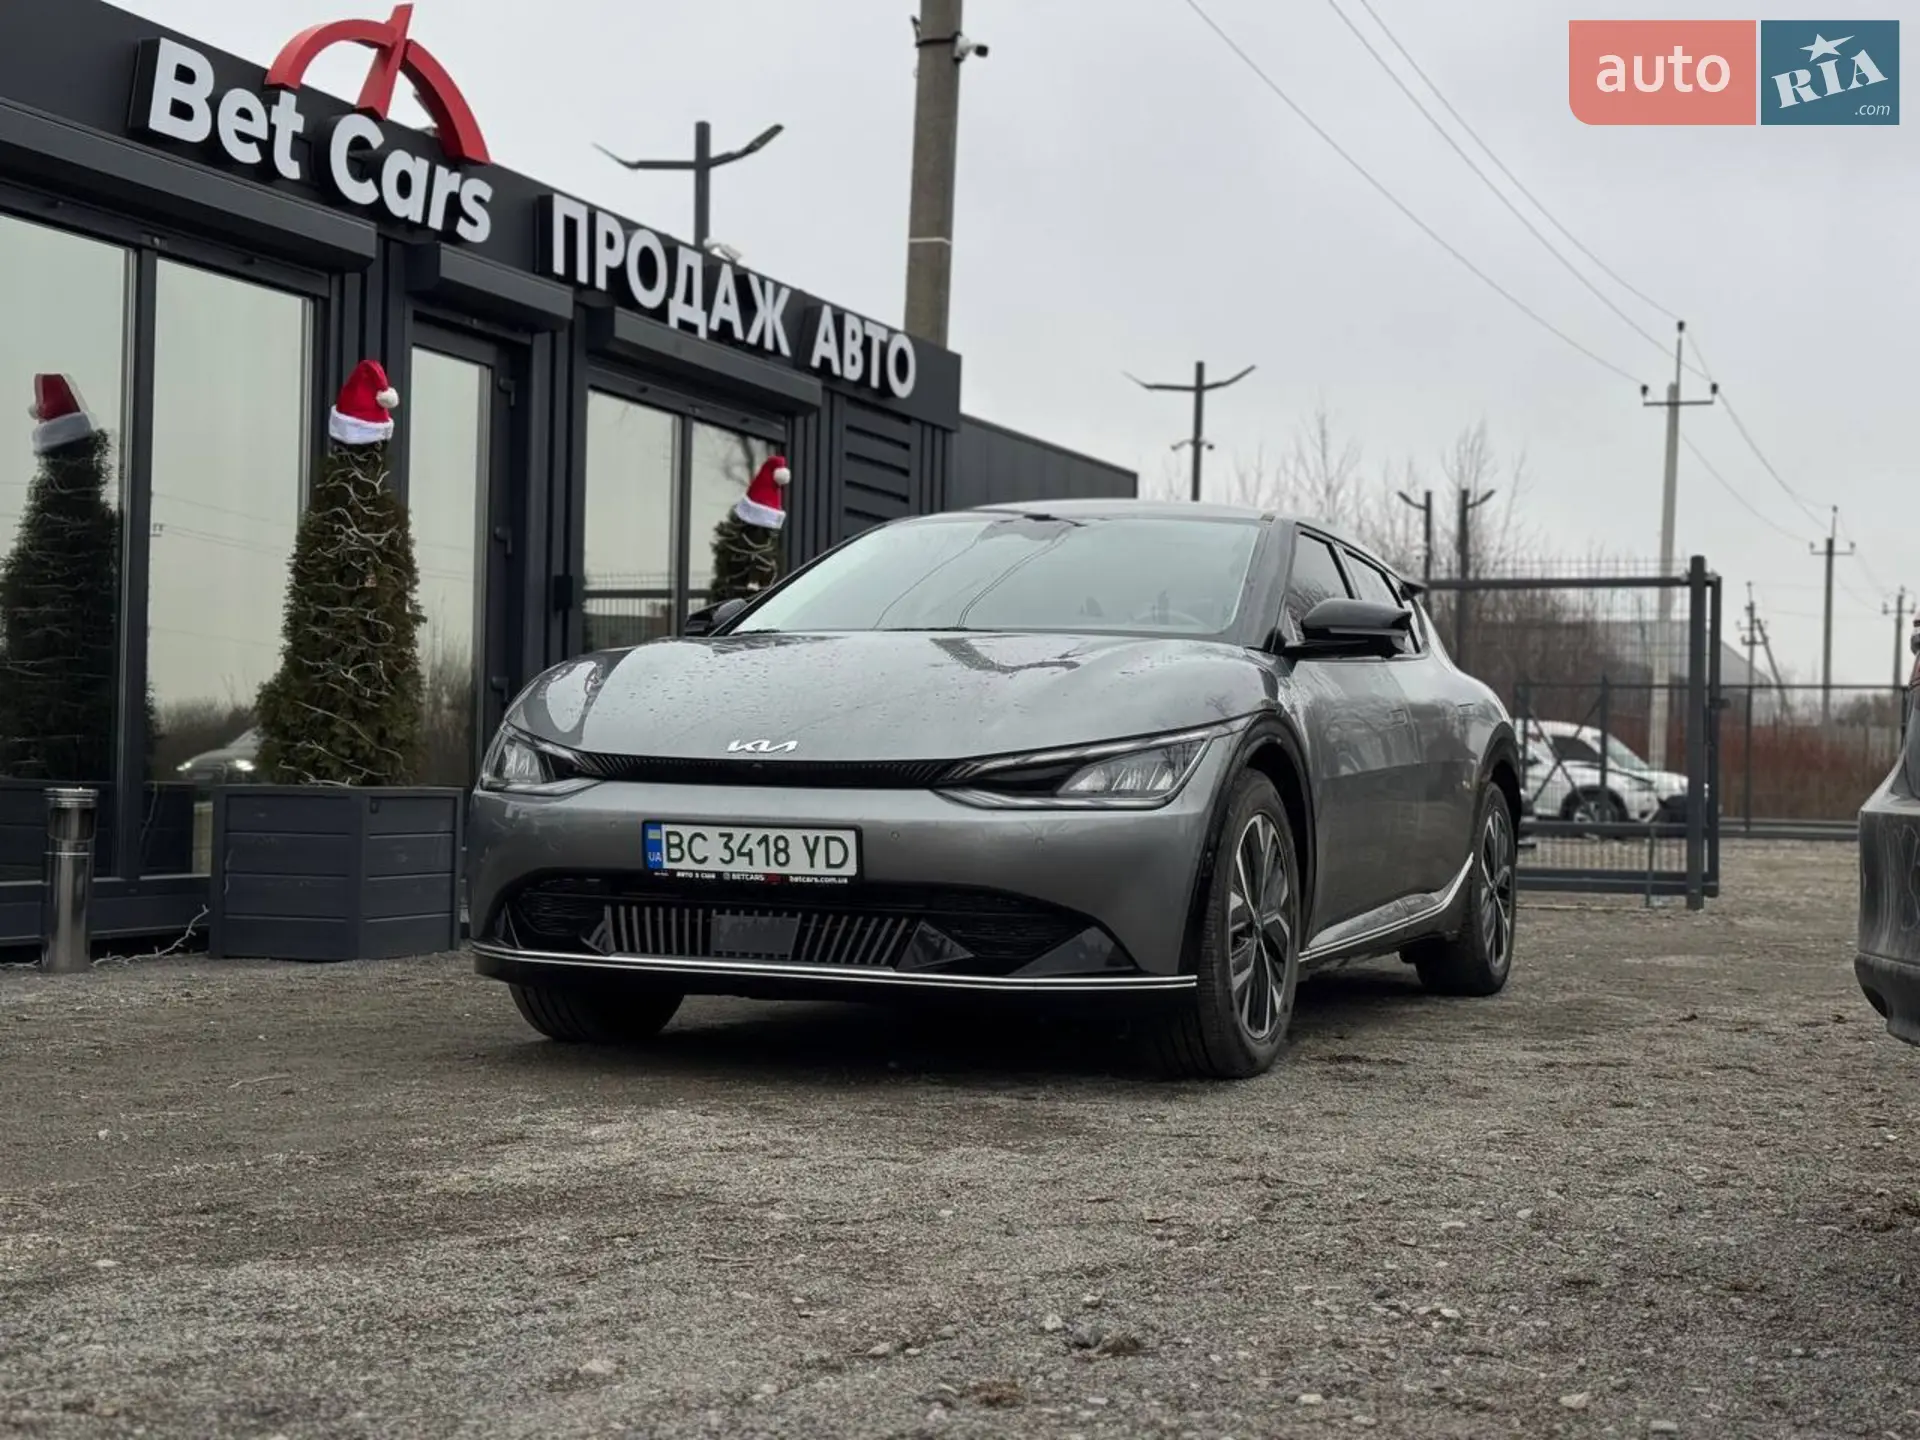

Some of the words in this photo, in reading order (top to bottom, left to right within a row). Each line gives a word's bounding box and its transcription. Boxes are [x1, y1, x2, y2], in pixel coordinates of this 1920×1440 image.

[149, 37, 304, 180] Bet
[330, 113, 493, 244] Cars
[552, 193, 792, 358] ПРОДАЖ
[811, 304, 916, 398] АВТО
[648, 853, 662, 862] UA
[665, 831, 709, 864] BC
[718, 833, 791, 867] 3418
[802, 835, 850, 869] YD
